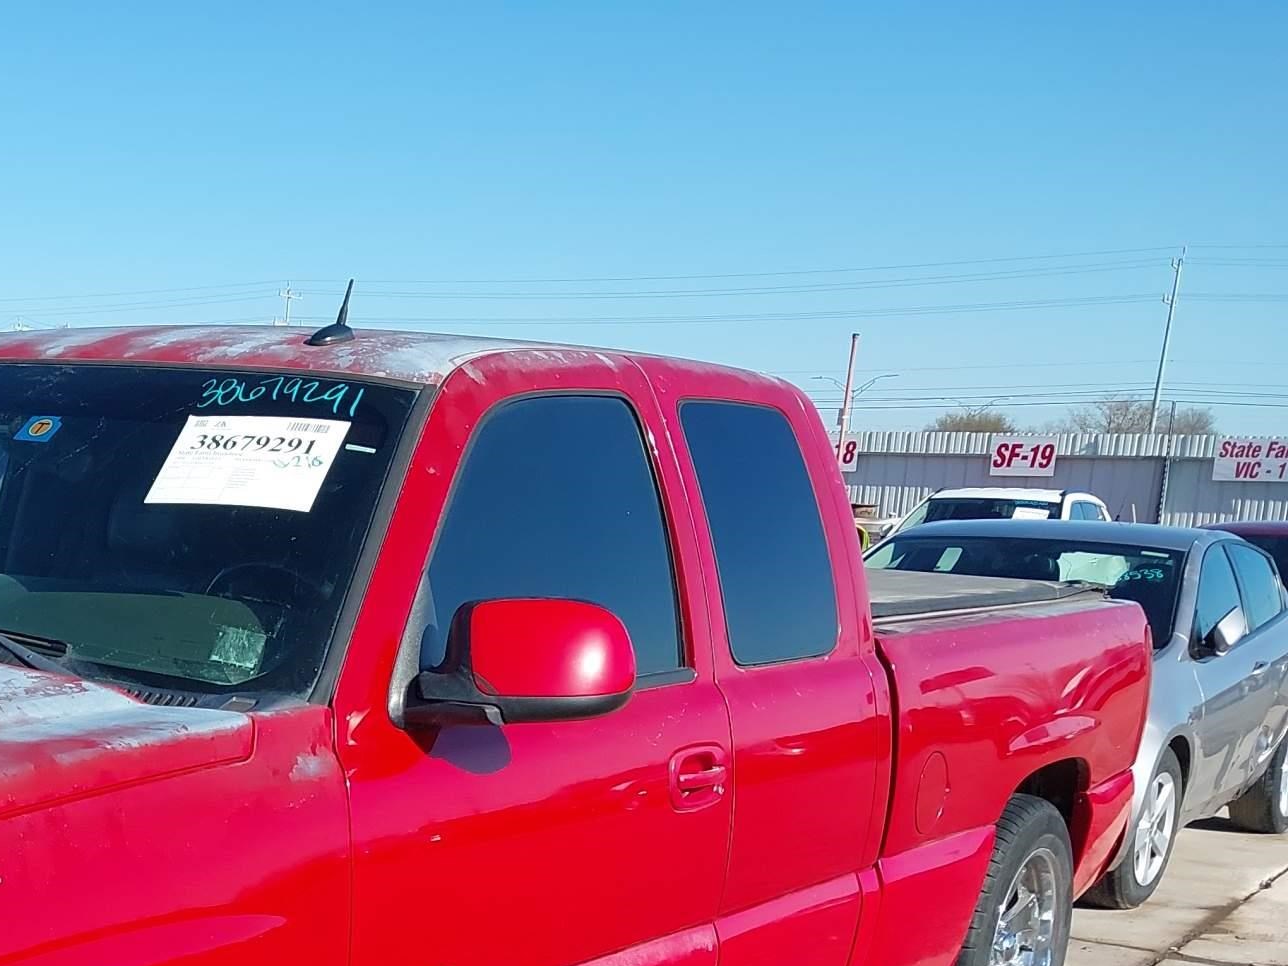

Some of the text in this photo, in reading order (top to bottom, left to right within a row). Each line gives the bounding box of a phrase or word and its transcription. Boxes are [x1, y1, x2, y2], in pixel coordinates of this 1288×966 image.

[197, 377, 364, 417] 38679291
[190, 434, 316, 454] 38679291
[1219, 441, 1262, 458] State
[993, 443, 1055, 468] SF-19
[1235, 461, 1261, 478] VIC
[1279, 462, 1288, 479] 1
